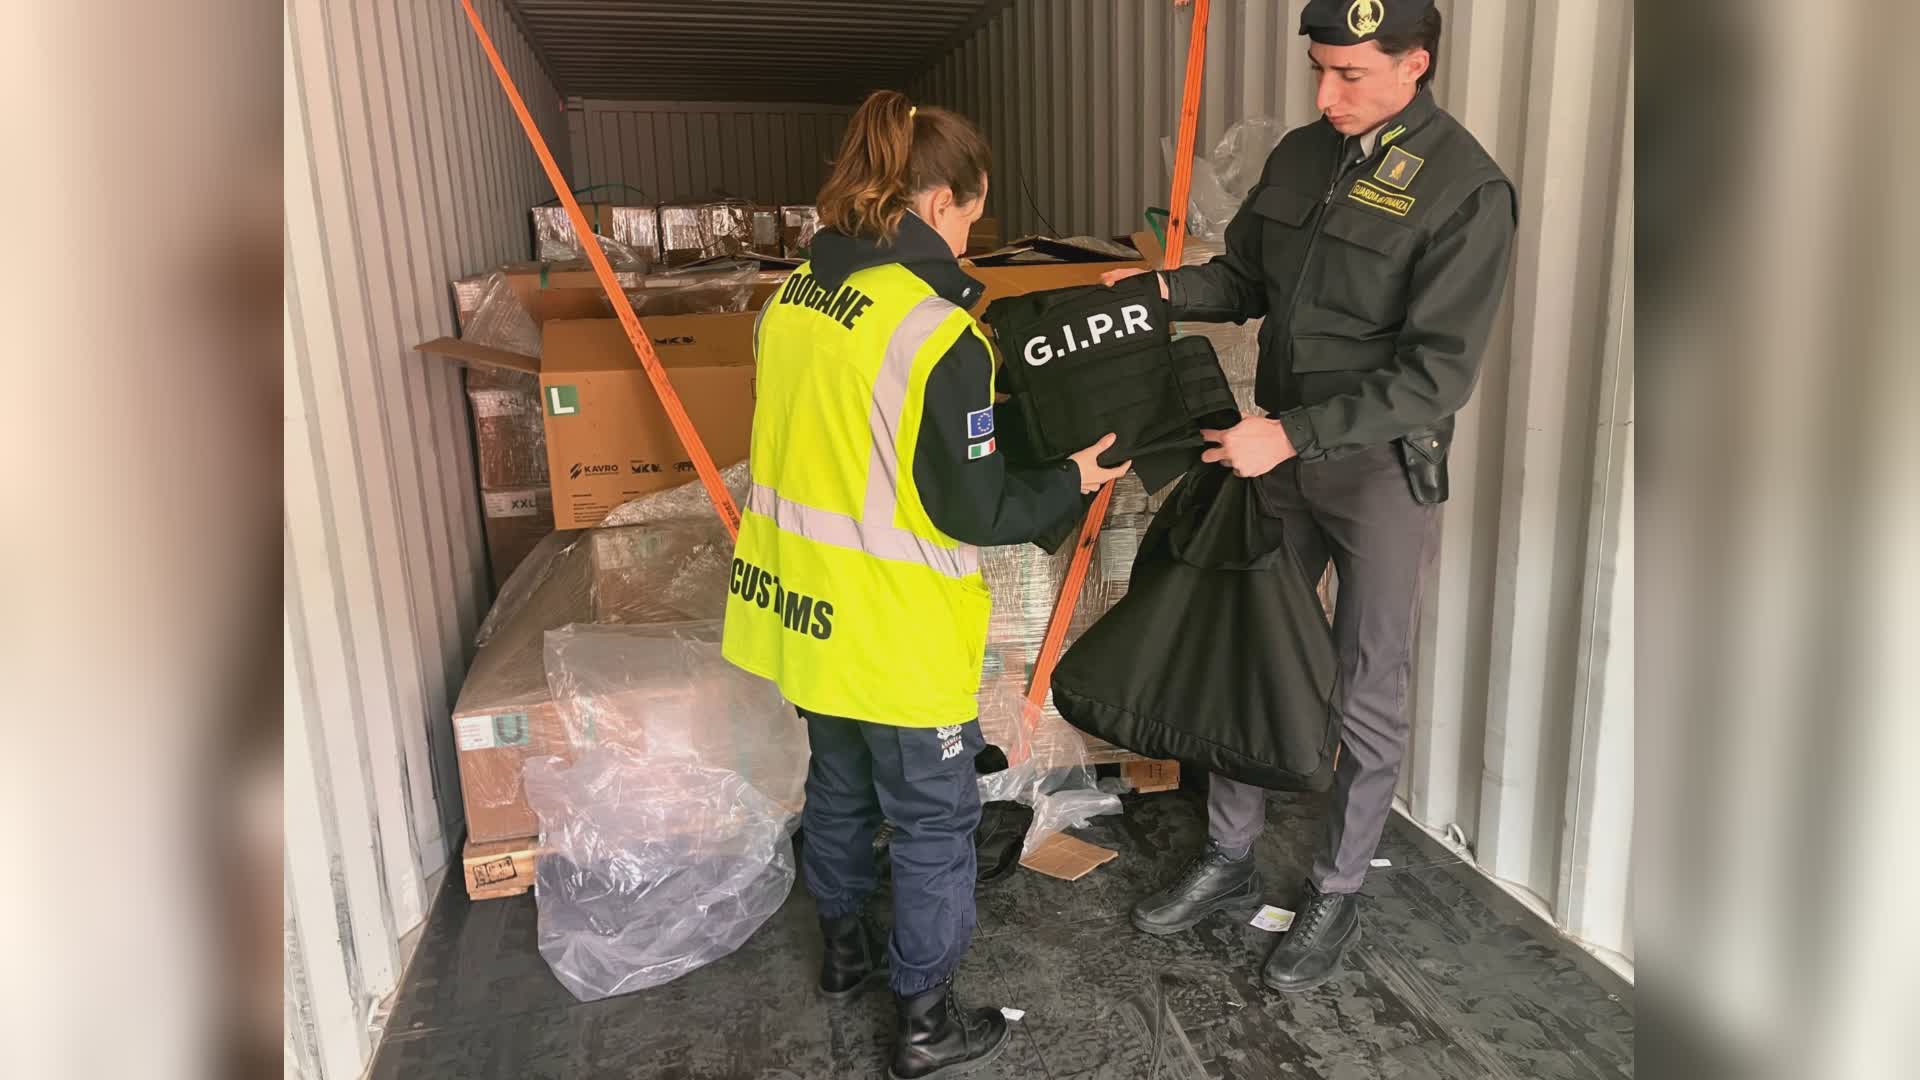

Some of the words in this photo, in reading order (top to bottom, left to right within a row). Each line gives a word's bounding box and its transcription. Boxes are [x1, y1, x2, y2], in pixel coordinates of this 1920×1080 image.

[779, 273, 874, 331] DOGANE
[1024, 304, 1153, 366] G.I.P.R
[551, 388, 574, 414] L
[584, 464, 619, 473] KAVRO
[511, 499, 536, 509] XXL
[941, 740, 964, 760] ADM
